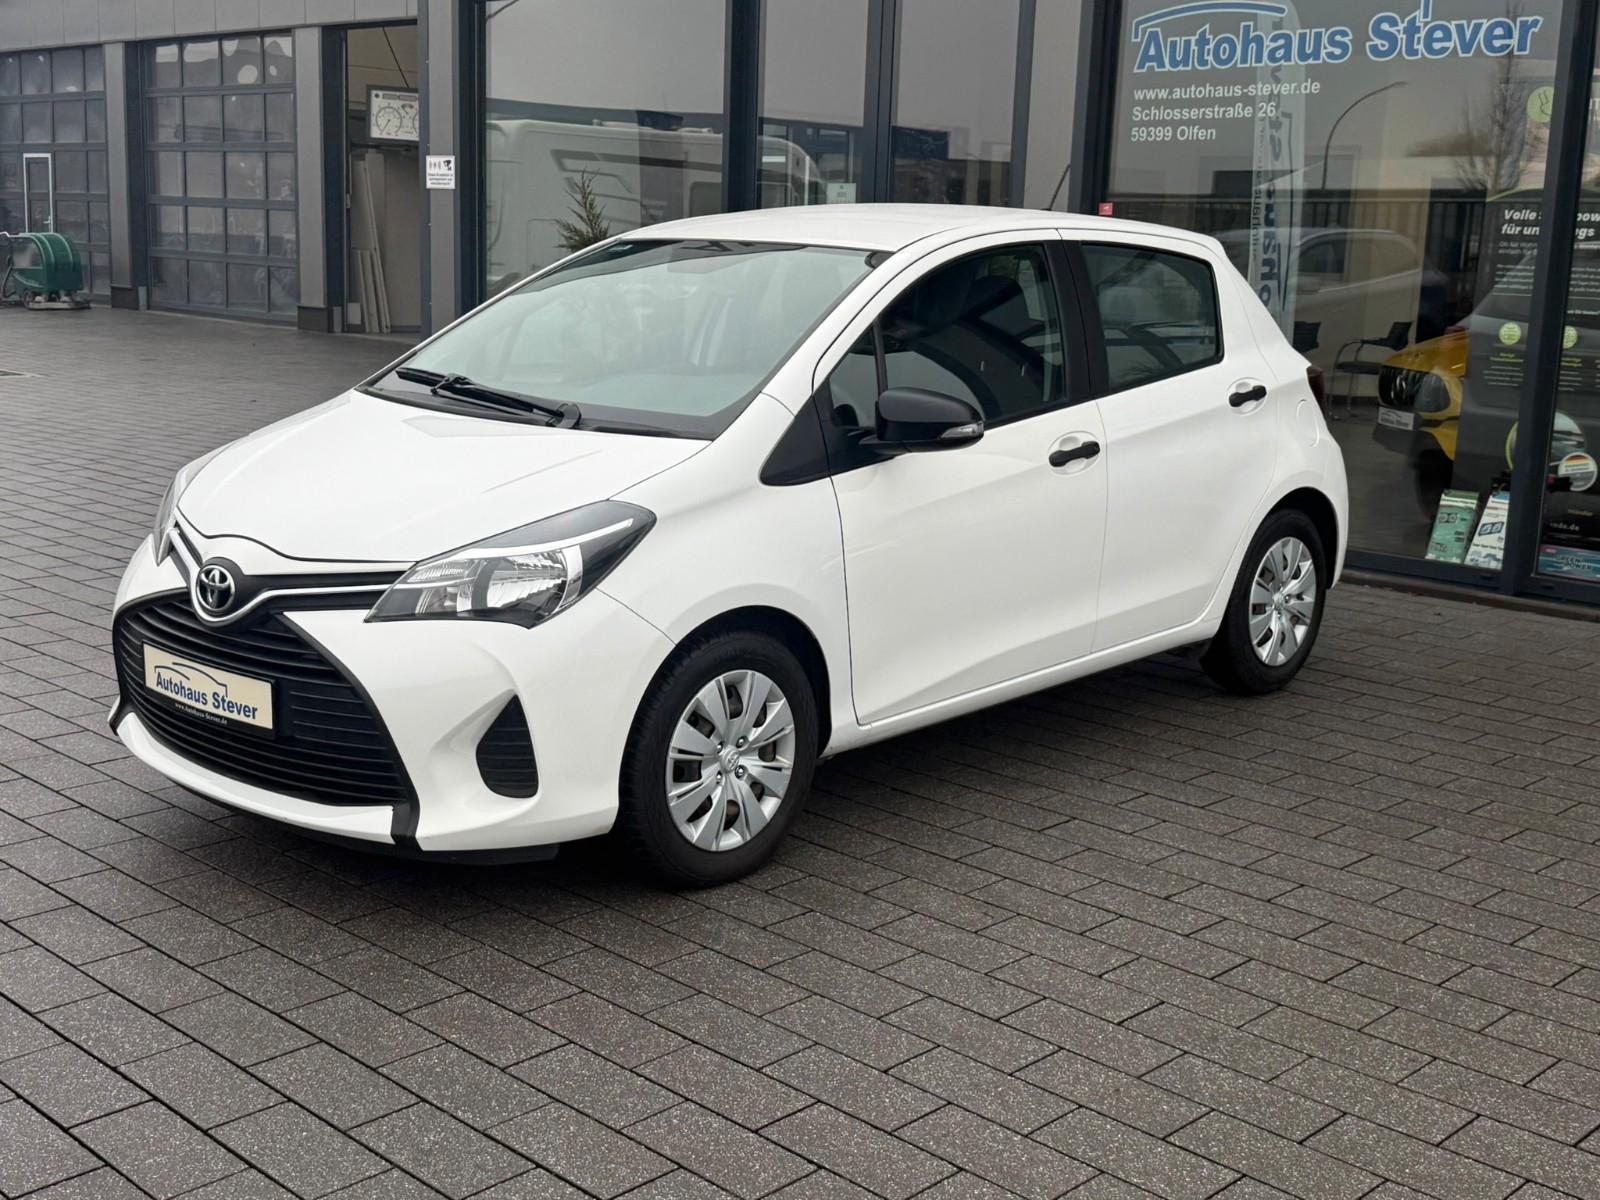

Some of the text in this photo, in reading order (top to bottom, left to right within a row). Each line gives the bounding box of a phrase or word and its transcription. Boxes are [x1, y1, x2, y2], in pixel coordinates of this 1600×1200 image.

[1134, 10, 1543, 73] Autohaus Stever
[1133, 78, 1321, 100] www.autohaus-stever.de
[1132, 102, 1276, 121] Schlosserstraße 26
[1131, 125, 1216, 142] 59399 Olfen
[1504, 209, 1537, 220] Volle
[1501, 223, 1522, 235] für
[156, 671, 258, 720] Autohaus Stever
